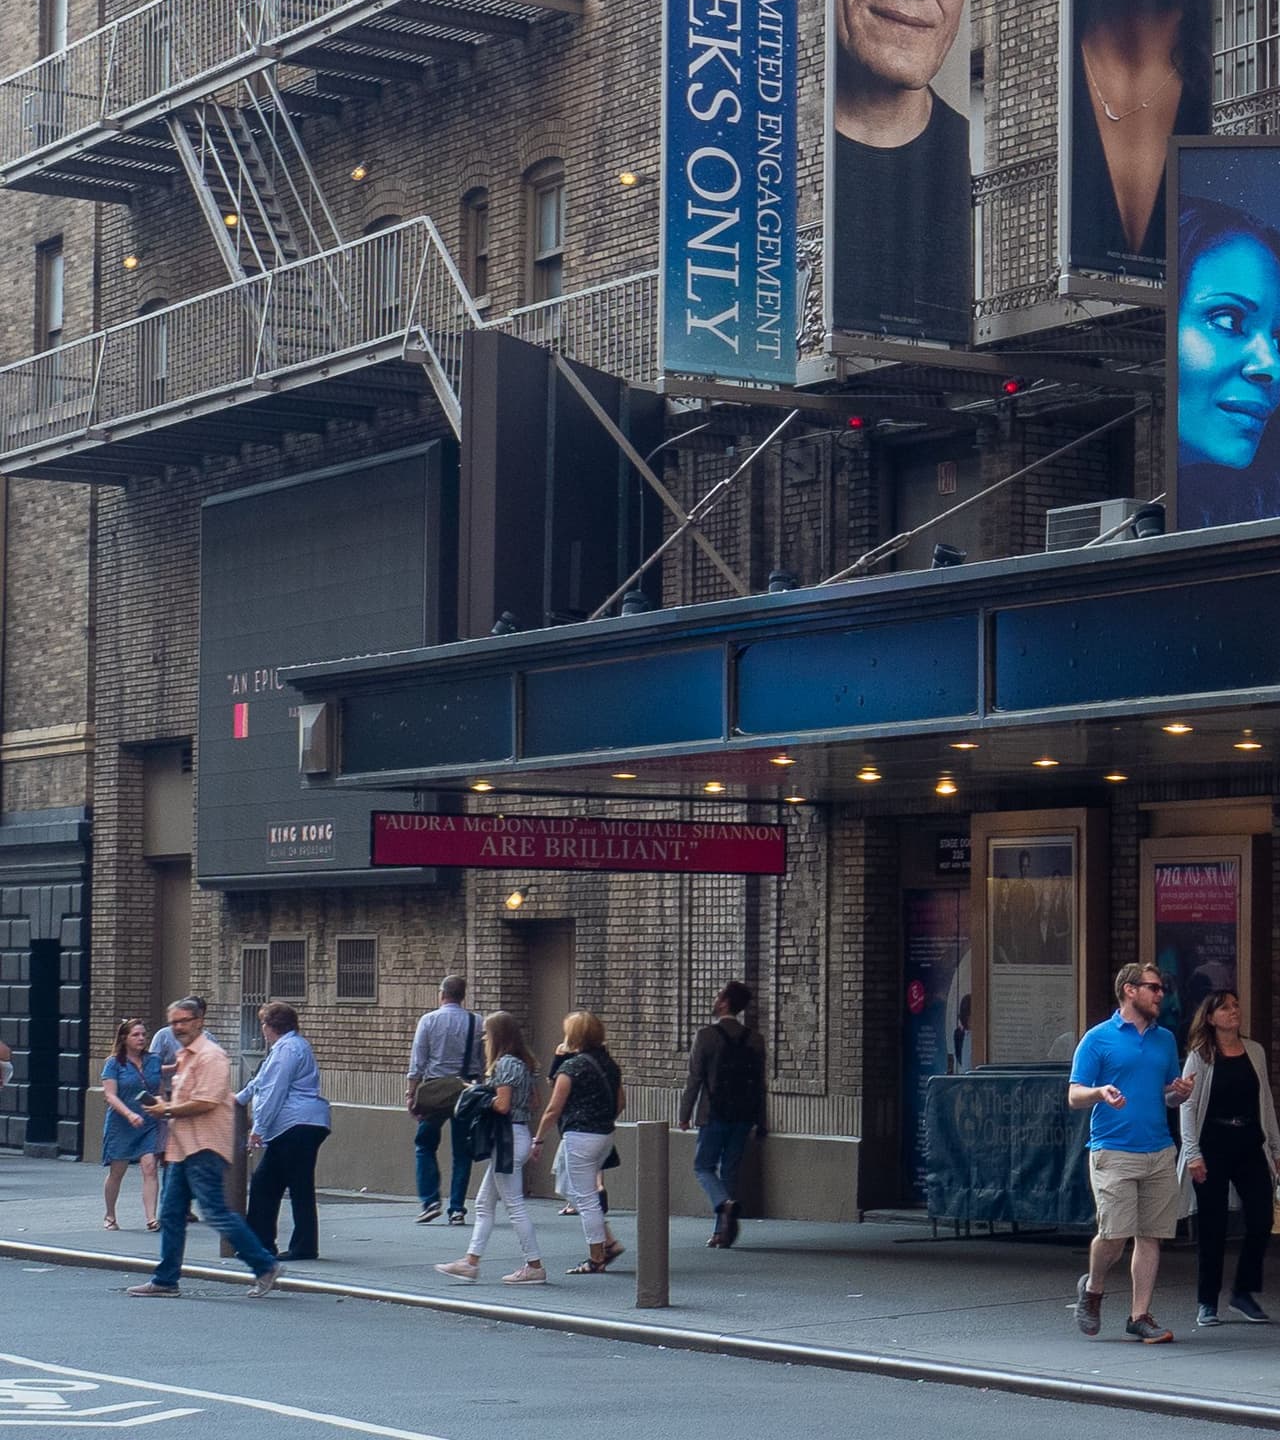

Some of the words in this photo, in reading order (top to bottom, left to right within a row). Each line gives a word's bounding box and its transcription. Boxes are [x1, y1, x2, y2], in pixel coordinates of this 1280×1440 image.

[754, 111, 785, 360] ENGAGEMENT
[685, 146, 741, 356] ONLY
[269, 826, 297, 844] KING
[301, 823, 333, 842] KONG
[379, 814, 456, 833] “AUDRA
[463, 816, 576, 836] McDONALD
[577, 826, 598, 837] and
[598, 821, 688, 840] MICHAEL
[690, 825, 782, 842] SHANNON
[478, 836, 537, 858] ARE
[543, 837, 701, 862] BRILLIANT.”
